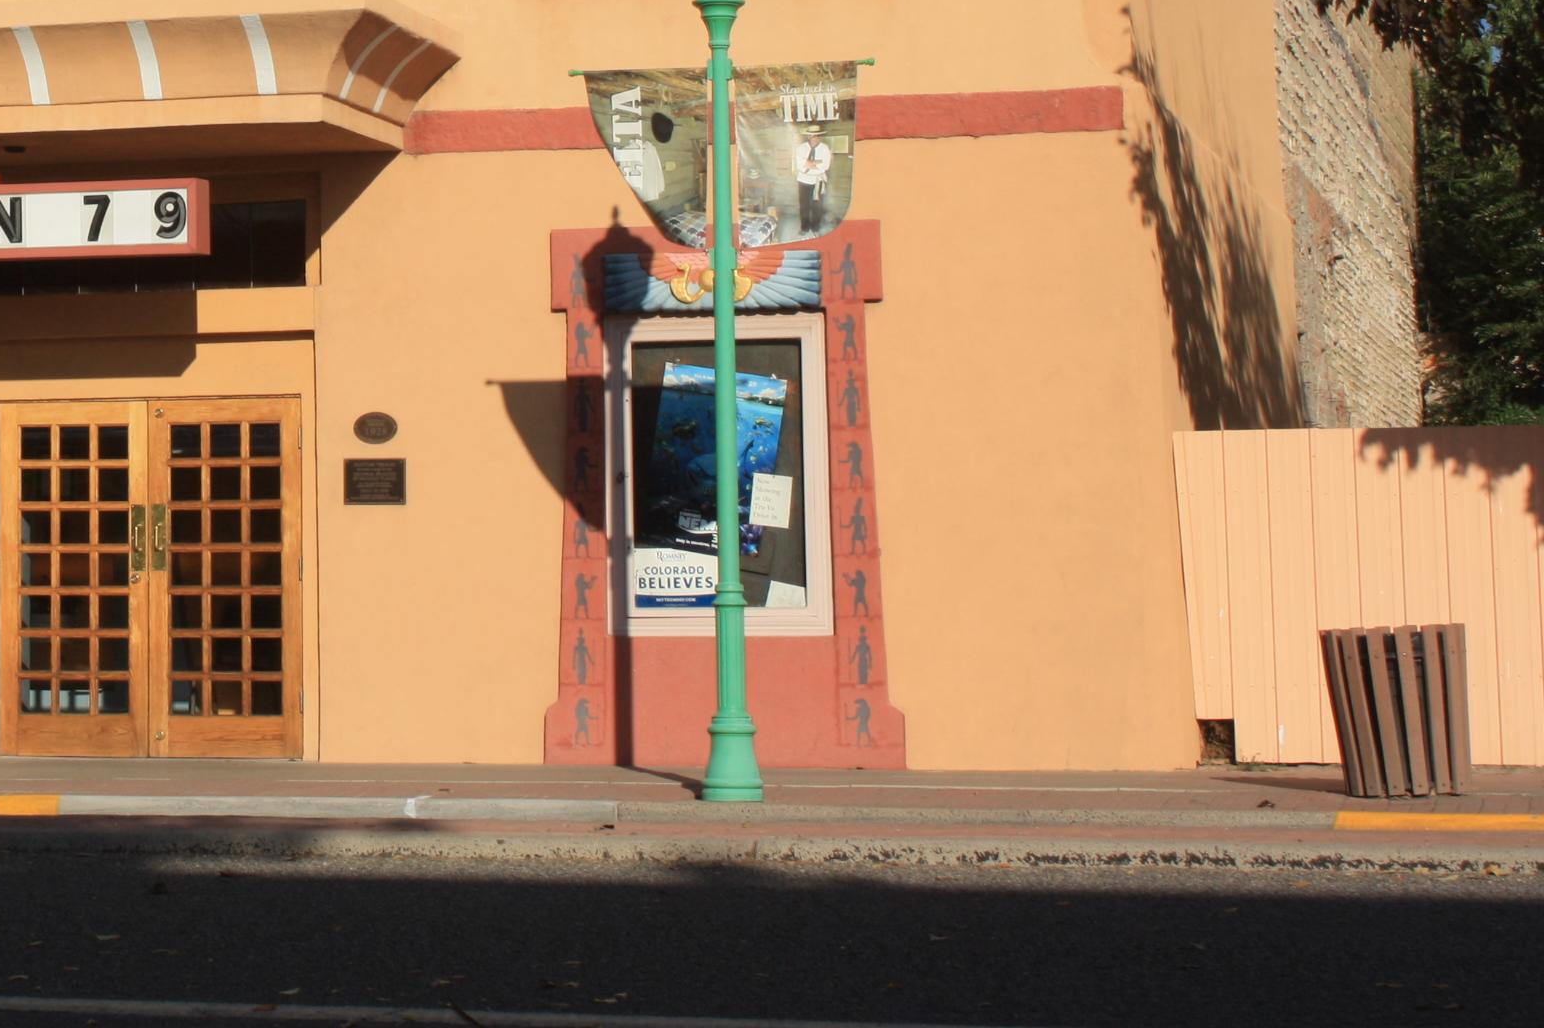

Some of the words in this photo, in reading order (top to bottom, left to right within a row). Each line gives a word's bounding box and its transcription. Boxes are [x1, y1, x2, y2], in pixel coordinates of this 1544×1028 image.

[779, 92, 840, 123] TIME
[611, 85, 643, 191] ELTA
[82, 194, 111, 243] 7
[153, 190, 188, 240] 9
[678, 514, 718, 532] NEM
[638, 576, 714, 589] BELIEVES
[644, 565, 705, 576] COLORADO
